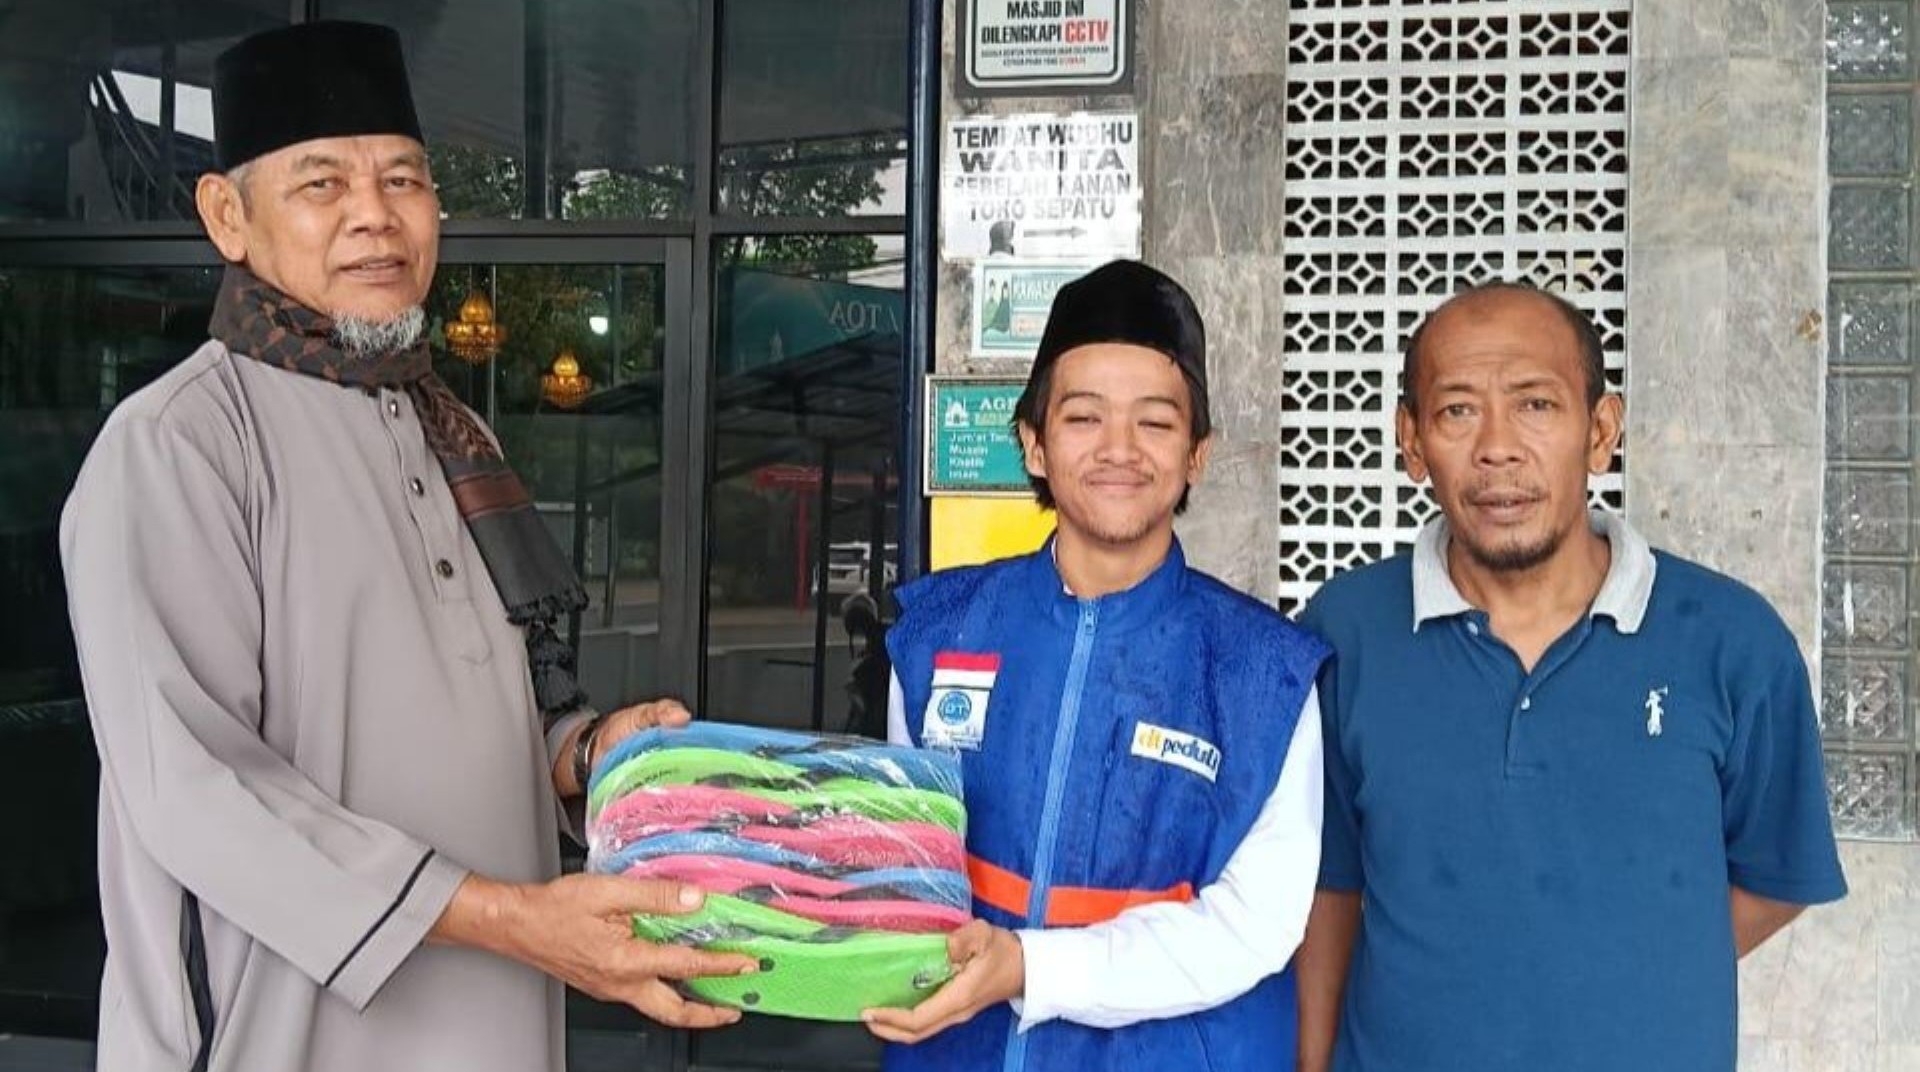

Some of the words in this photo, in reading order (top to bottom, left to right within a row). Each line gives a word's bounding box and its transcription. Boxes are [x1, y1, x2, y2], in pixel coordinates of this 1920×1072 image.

[1007, 1, 1062, 19] MASJID
[1065, 0, 1084, 17] INI
[981, 25, 1062, 44] DILENGKAPI
[1065, 20, 1108, 43] CCTV
[953, 125, 1041, 148] TEMPAT
[1047, 121, 1132, 145] WUDHU
[960, 149, 1125, 173] WANITA
[970, 200, 1025, 221] TOKO
[1033, 198, 1116, 219] SEPATU
[1161, 738, 1219, 770] peduli
